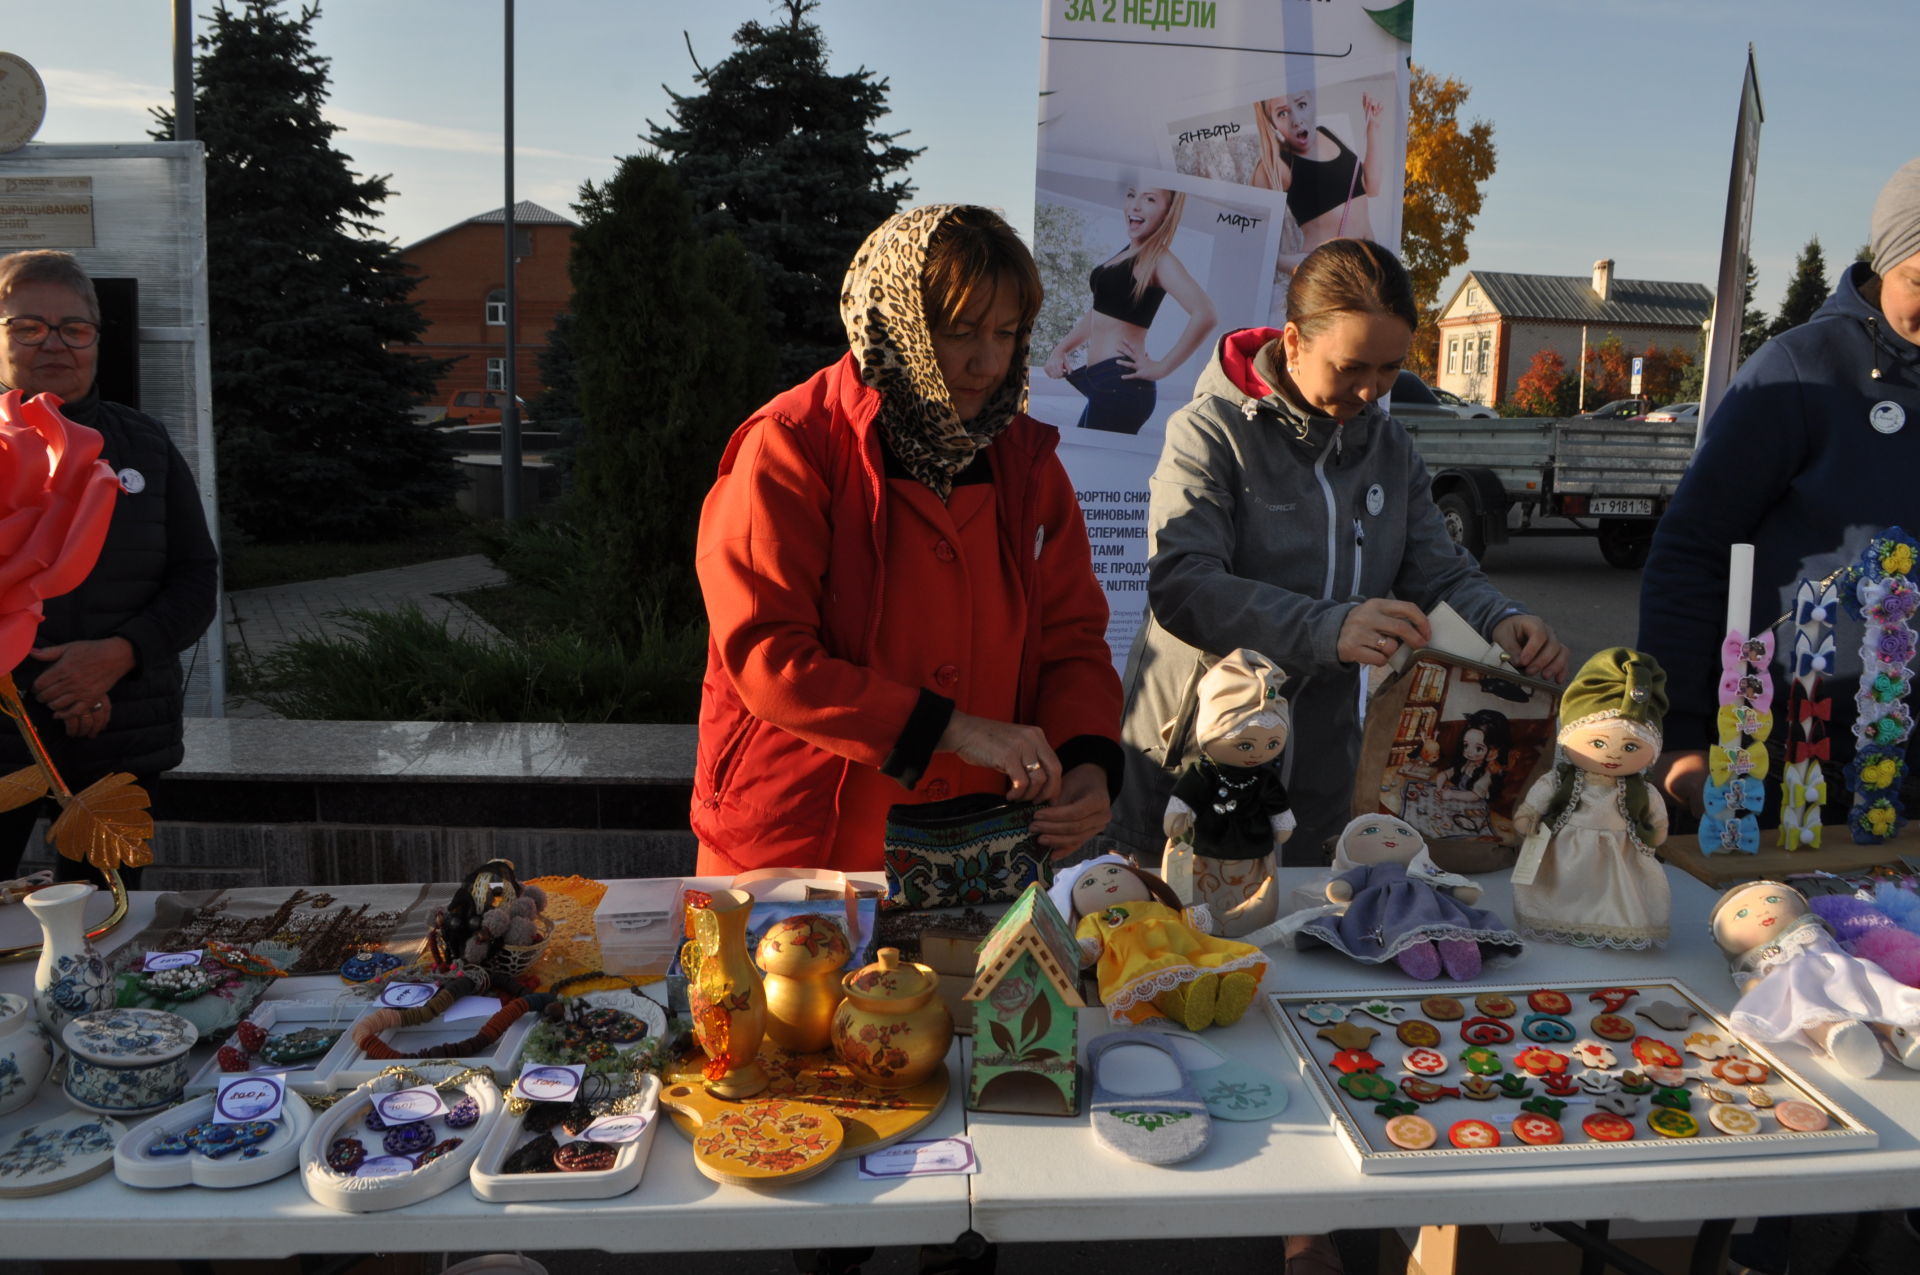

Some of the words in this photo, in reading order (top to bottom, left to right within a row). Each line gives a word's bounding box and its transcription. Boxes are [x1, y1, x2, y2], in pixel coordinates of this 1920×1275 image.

[1064, 0, 1096, 22] ЗА
[1102, 0, 1116, 23] 2
[1123, 0, 1217, 32] НЕДЕЛИ
[1179, 122, 1240, 146] январь
[1216, 213, 1262, 233] март
[1609, 500, 1634, 513] 9181
